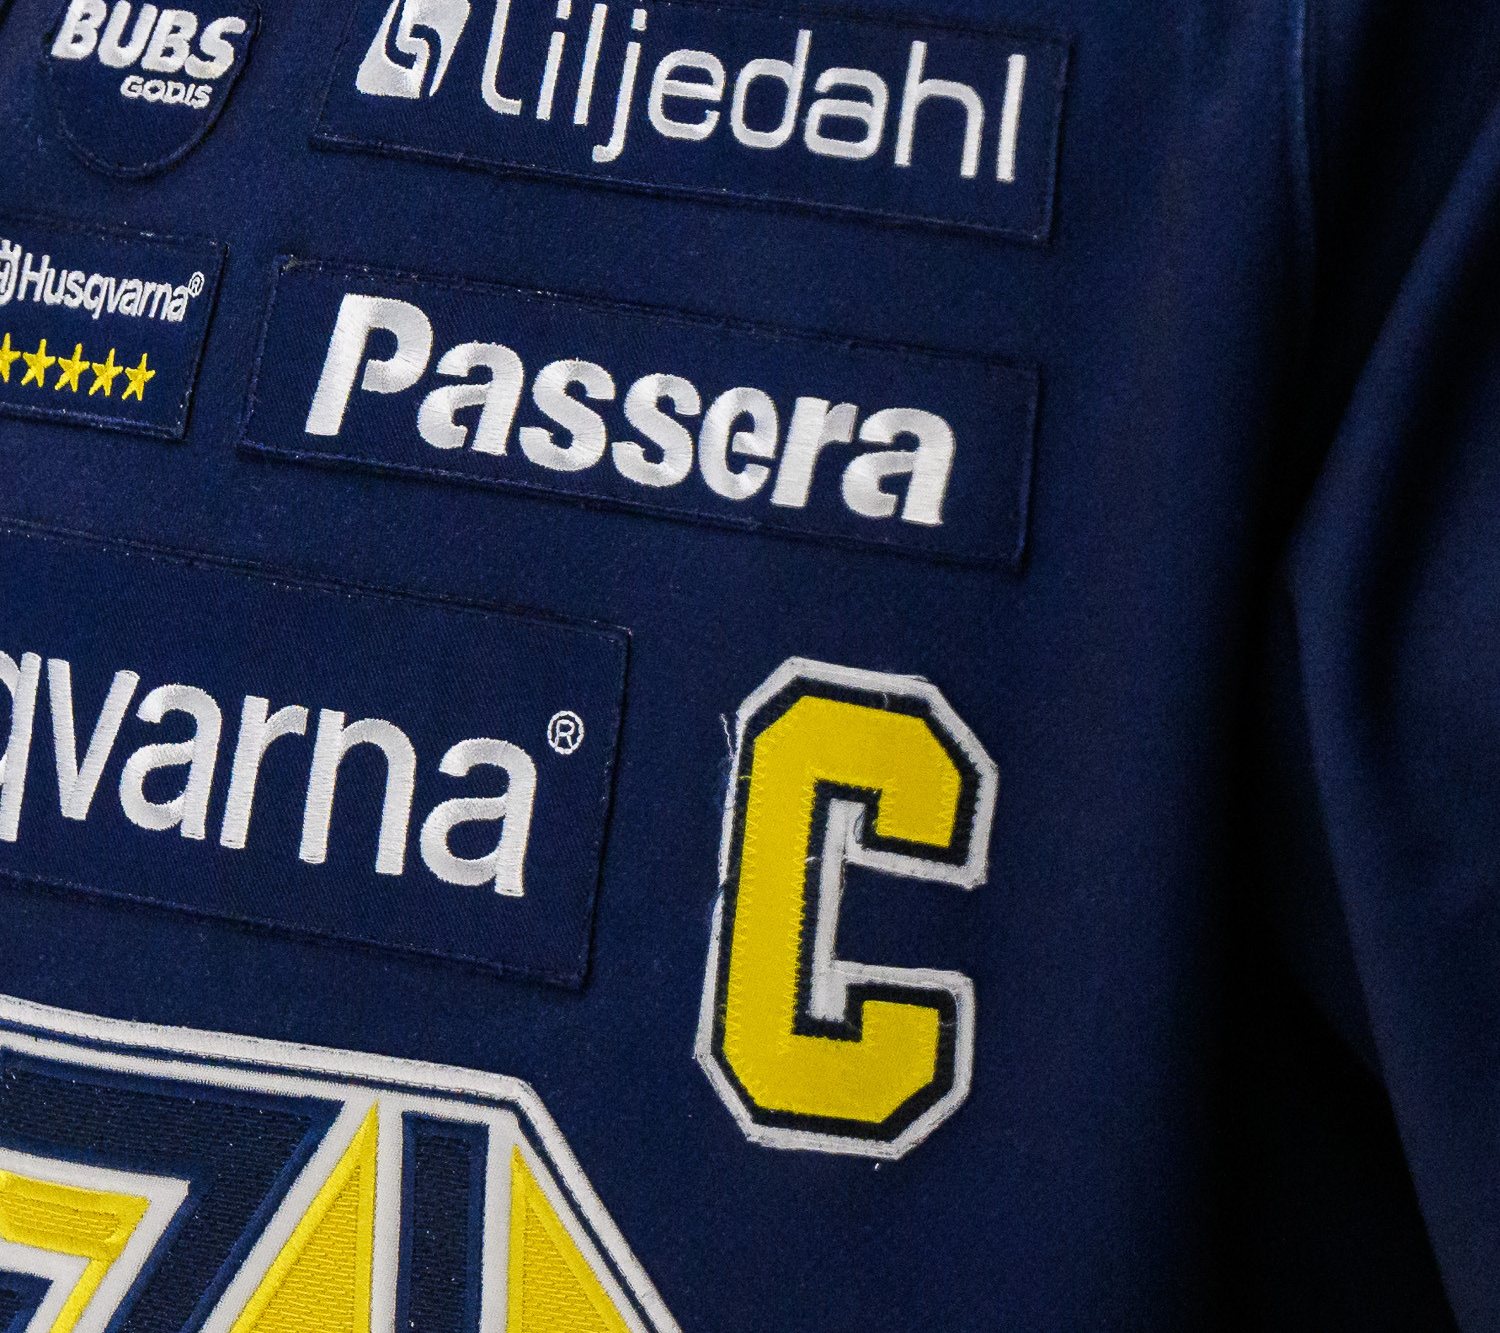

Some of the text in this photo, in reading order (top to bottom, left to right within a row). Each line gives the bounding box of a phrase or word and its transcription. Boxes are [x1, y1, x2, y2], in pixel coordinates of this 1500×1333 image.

[119, 74, 215, 110] GODIS
[303, 292, 957, 528] Passera
[694, 655, 998, 1162] C
